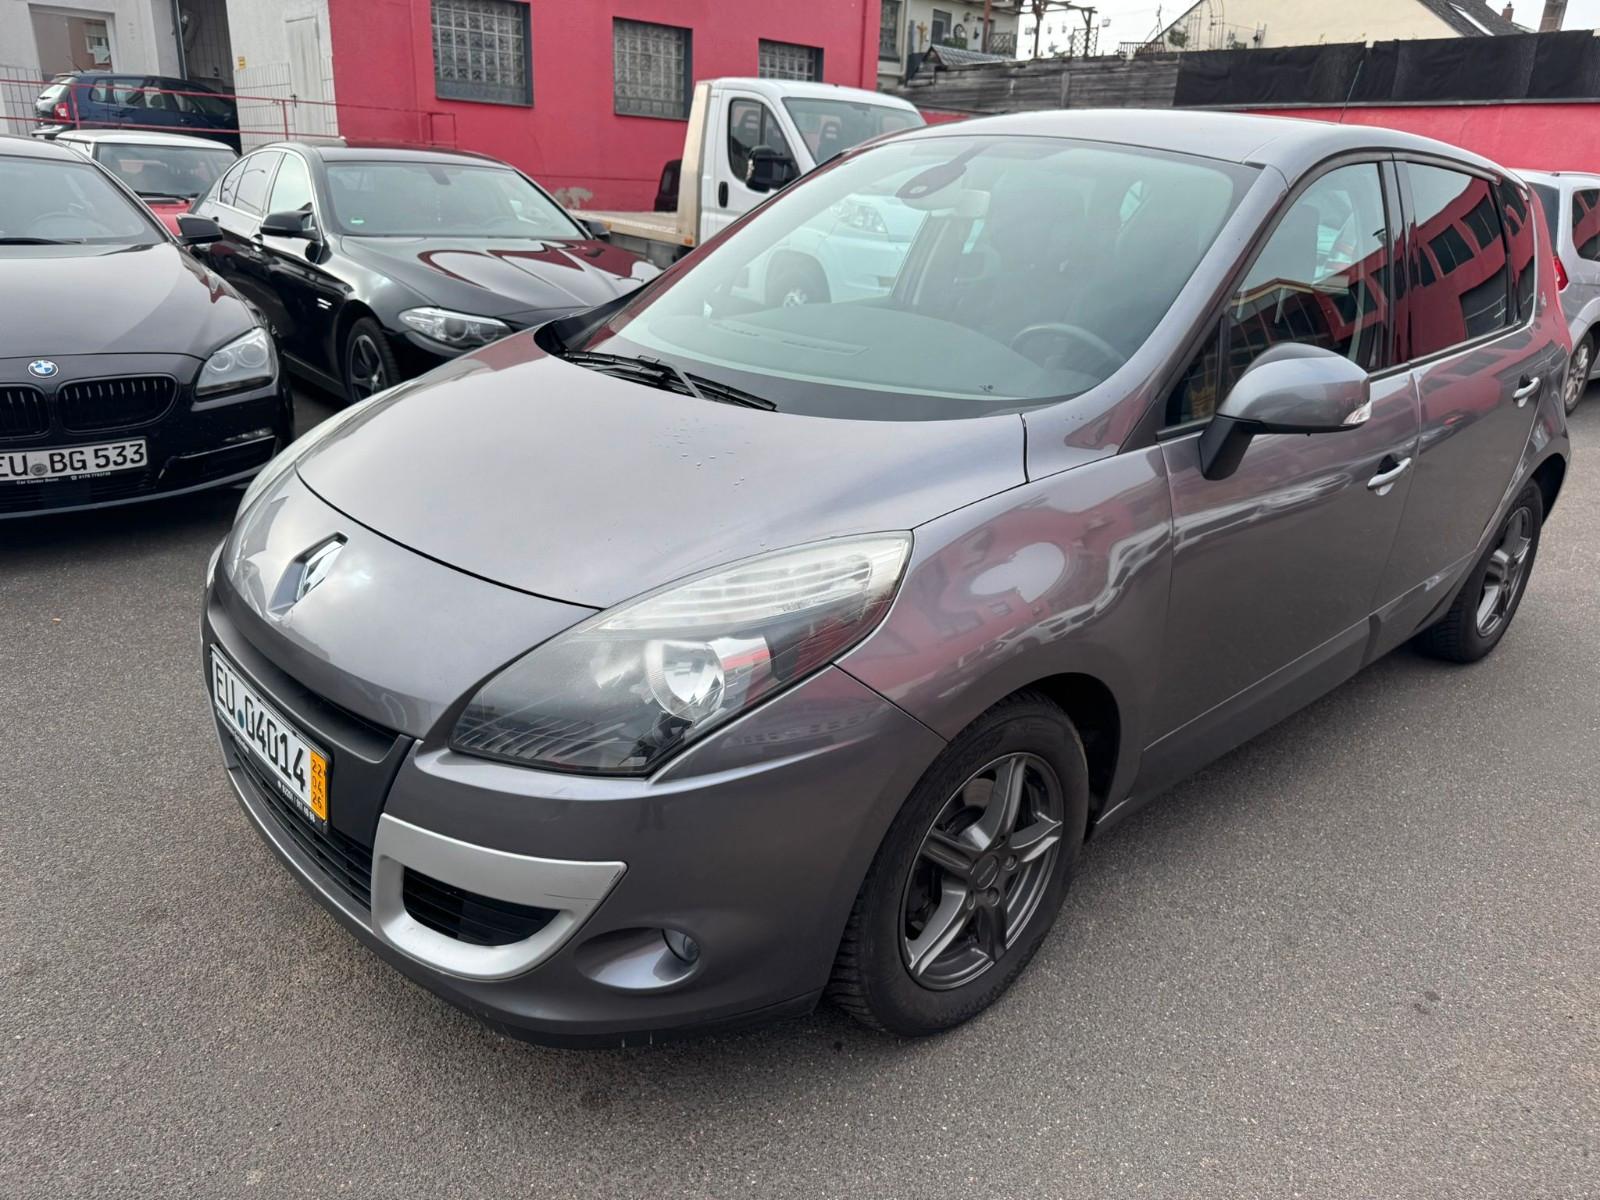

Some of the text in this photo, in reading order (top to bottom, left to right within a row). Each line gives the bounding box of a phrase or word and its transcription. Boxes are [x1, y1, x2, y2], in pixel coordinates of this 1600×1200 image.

[48, 451, 87, 474] BG
[93, 443, 144, 469] 533
[216, 661, 235, 721] EU
[245, 695, 305, 793] 04014
[312, 759, 323, 777] 22
[312, 777, 323, 794] 04
[312, 791, 323, 809] 26
